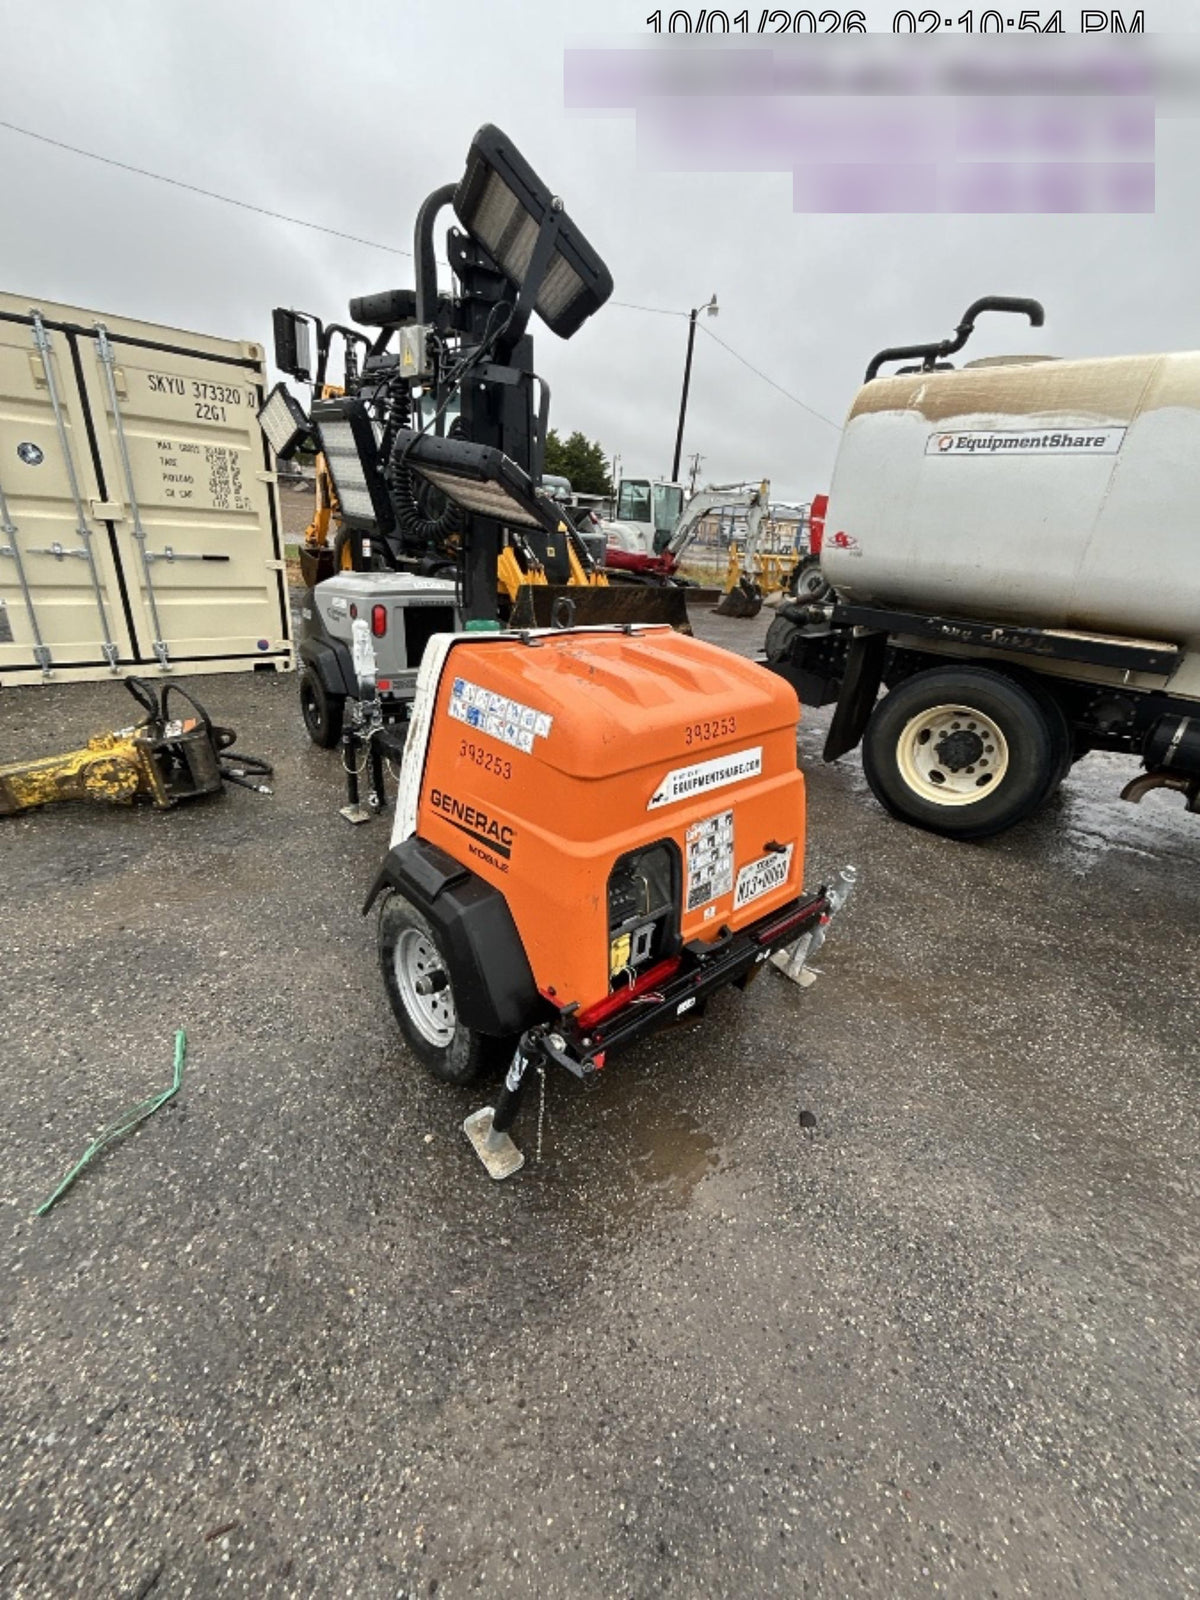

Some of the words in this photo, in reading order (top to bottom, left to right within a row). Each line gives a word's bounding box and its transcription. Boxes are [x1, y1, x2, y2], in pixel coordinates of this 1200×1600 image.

[147, 374, 185, 395] SKYU
[191, 382, 241, 405] 373320
[195, 402, 226, 422] 22G1
[955, 434, 1106, 451] EquipmentShare
[685, 716, 736, 746] 393253
[459, 740, 512, 779] 393253
[431, 788, 513, 847] GENERAC
